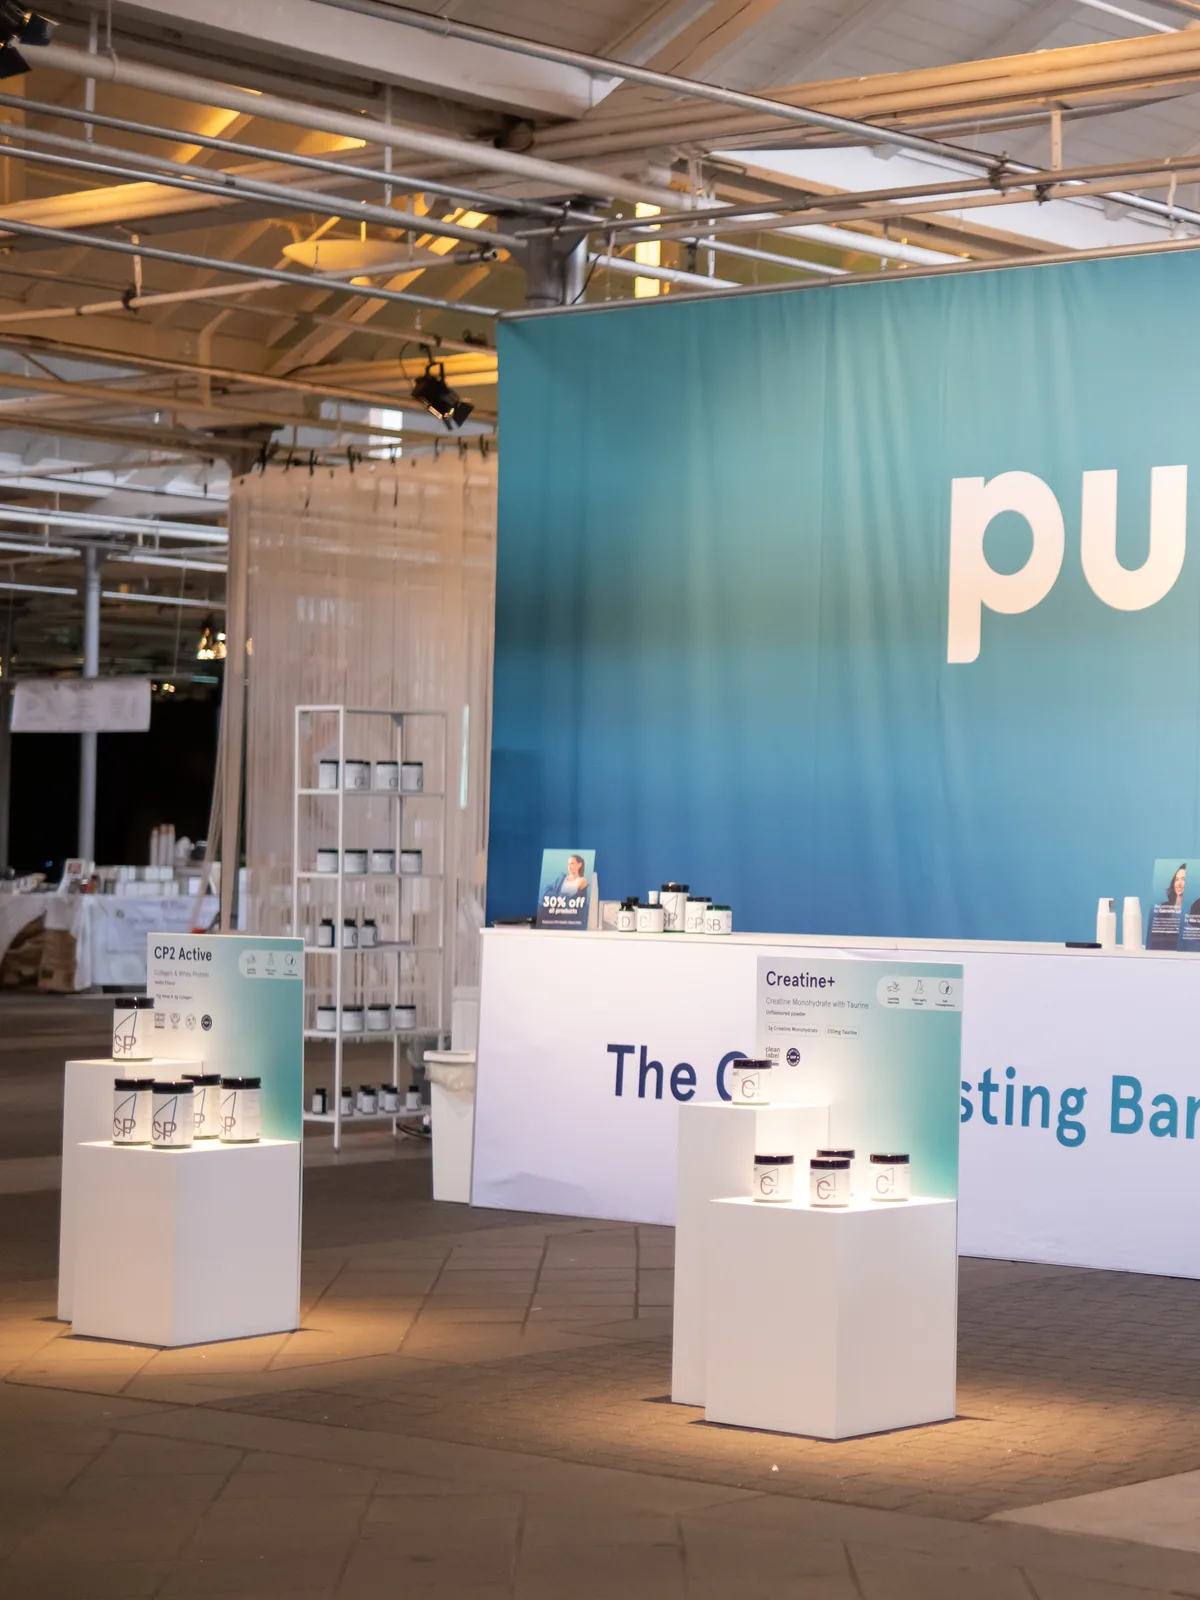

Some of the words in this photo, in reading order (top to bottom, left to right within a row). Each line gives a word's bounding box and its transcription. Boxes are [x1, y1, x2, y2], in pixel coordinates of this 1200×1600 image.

[543, 896, 567, 908] 30%
[568, 896, 586, 909] off
[621, 915, 631, 929] D
[154, 946, 175, 960] CP2
[178, 947, 212, 961] Active
[766, 970, 836, 988] Creatine+
[766, 997, 791, 1005] Creatine
[792, 998, 832, 1008] Monohydrate
[833, 1000, 846, 1008] with
[847, 1000, 870, 1009] Taurine
[607, 1044, 697, 1102] The
